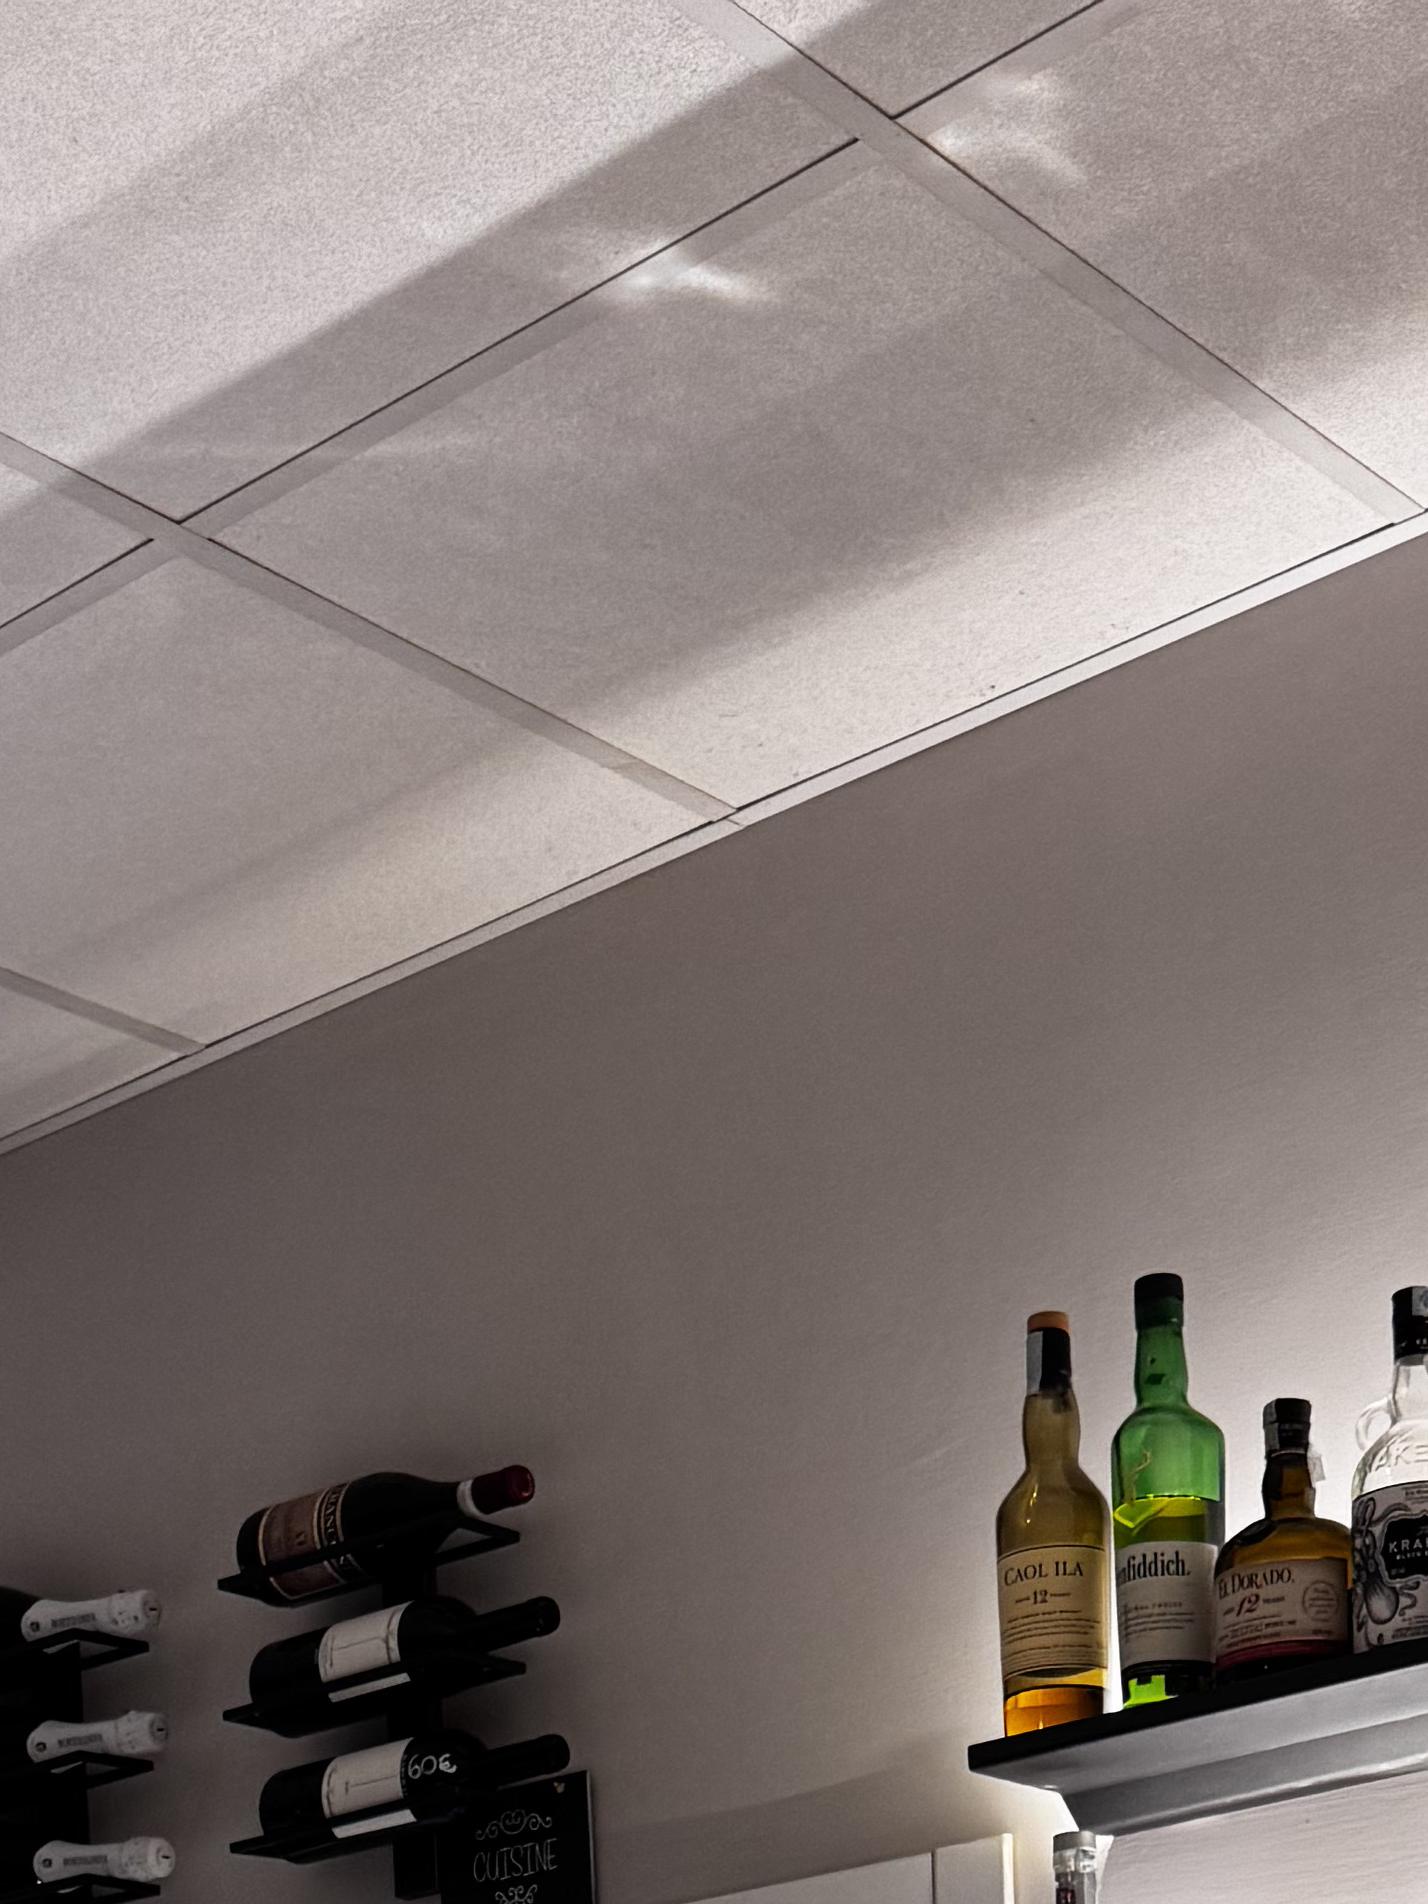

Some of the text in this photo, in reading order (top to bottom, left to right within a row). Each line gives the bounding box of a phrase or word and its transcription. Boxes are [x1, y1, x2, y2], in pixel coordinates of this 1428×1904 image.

[1004, 1561, 1084, 1587] CAOL ILA
[1032, 1590, 1049, 1605] 12
[1235, 1594, 1260, 1617] 12
[473, 1838, 558, 1882] CUISINE
